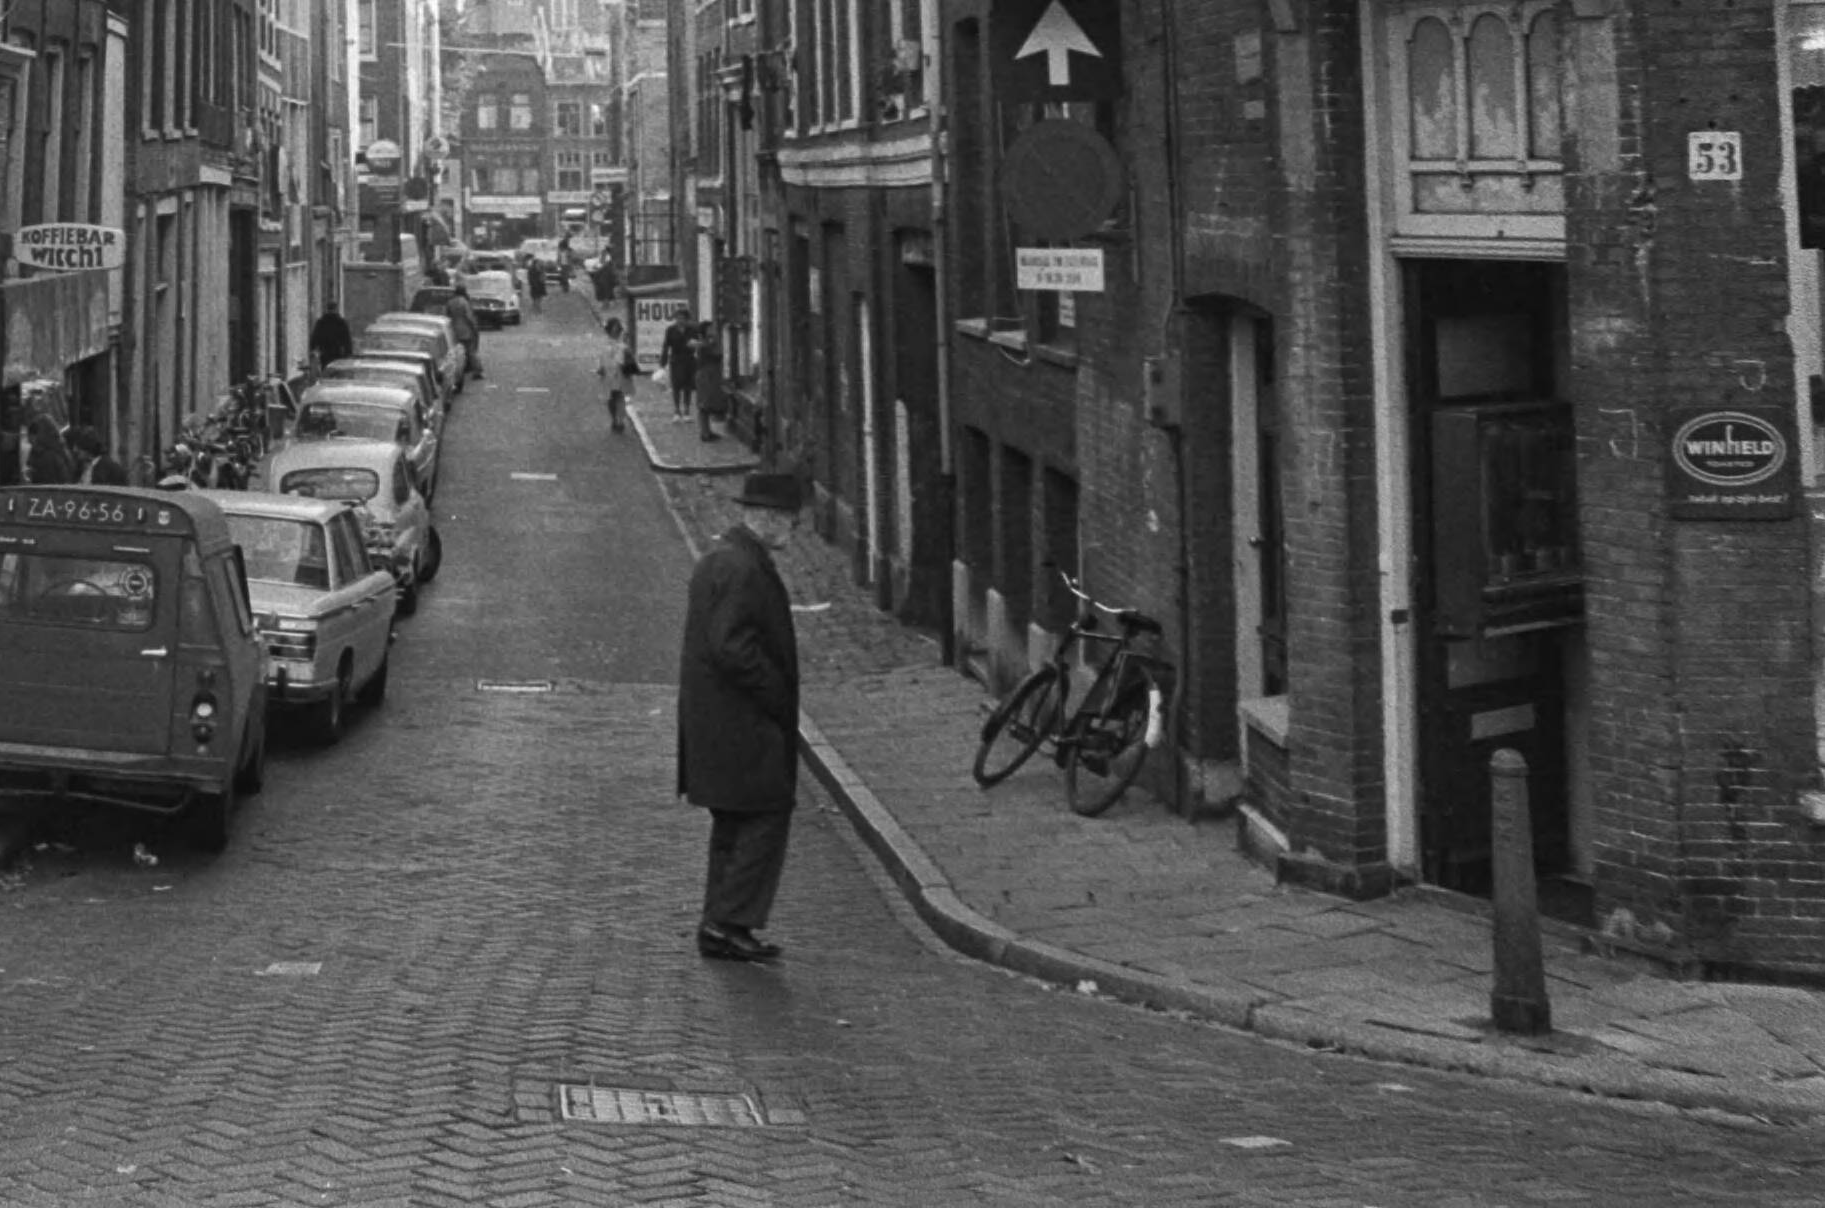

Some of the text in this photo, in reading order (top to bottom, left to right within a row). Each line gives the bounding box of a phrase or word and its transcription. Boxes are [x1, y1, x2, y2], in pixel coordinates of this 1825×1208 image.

[1695, 141, 1737, 174] 53
[21, 227, 115, 246] KOFFIEBAR
[1686, 425, 1775, 455] WINFIELD
[29, 498, 124, 522] ZA-96-56
